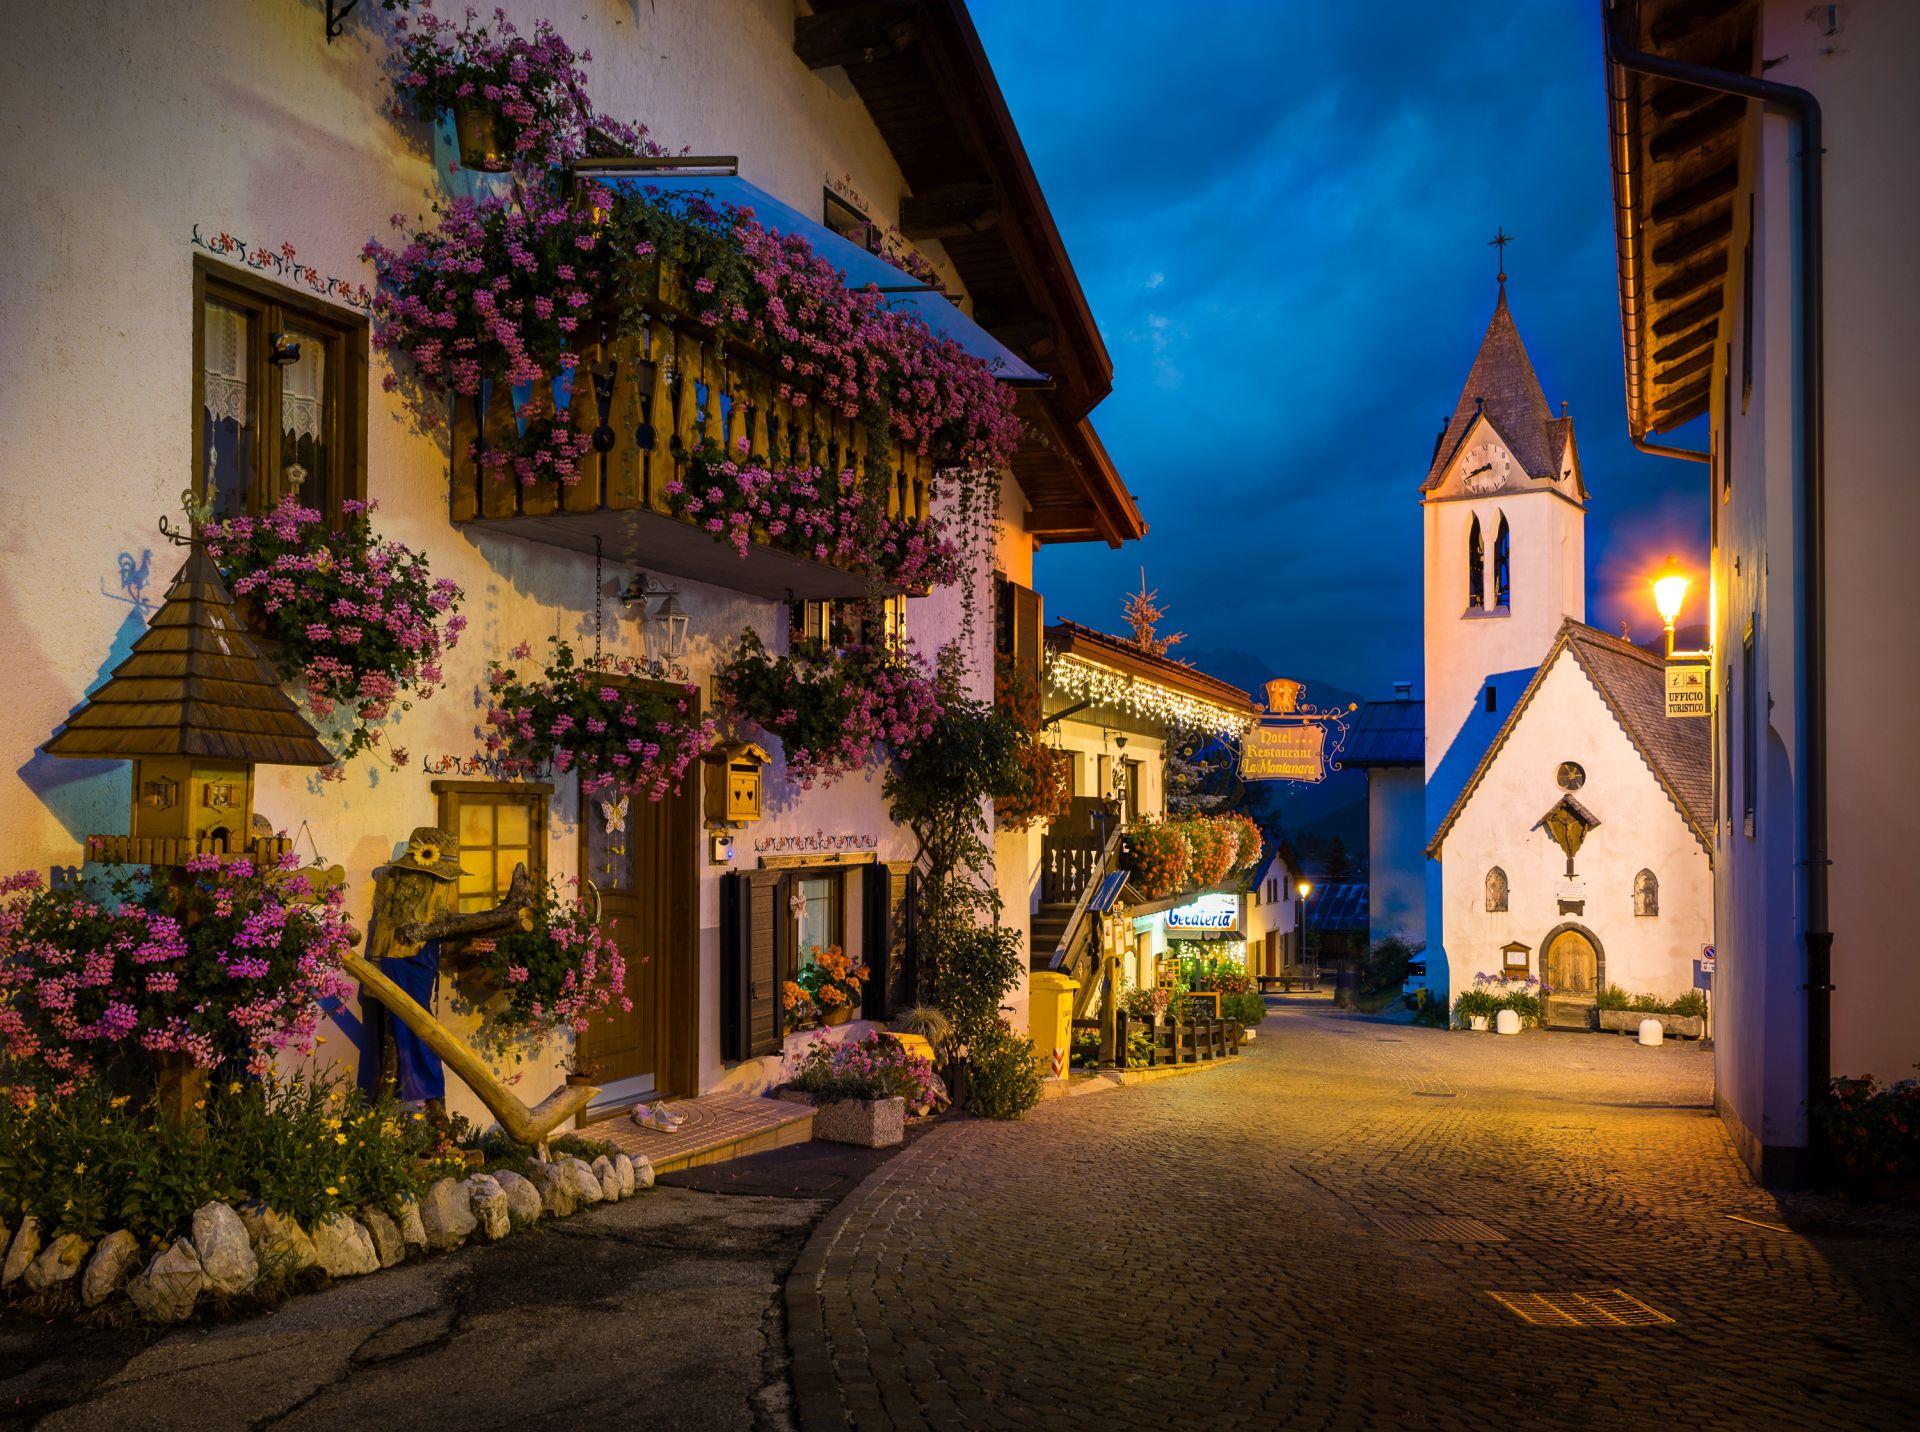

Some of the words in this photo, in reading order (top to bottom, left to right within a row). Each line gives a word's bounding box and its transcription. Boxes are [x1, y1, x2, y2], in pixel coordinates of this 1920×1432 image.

[1668, 691, 1703, 702] UFFICIO
[1668, 703, 1704, 713] TURISTICO
[1260, 729, 1292, 745] Hotel
[1247, 744, 1311, 759] Restaurant
[1242, 759, 1258, 773] La
[1258, 760, 1315, 774] Montanara
